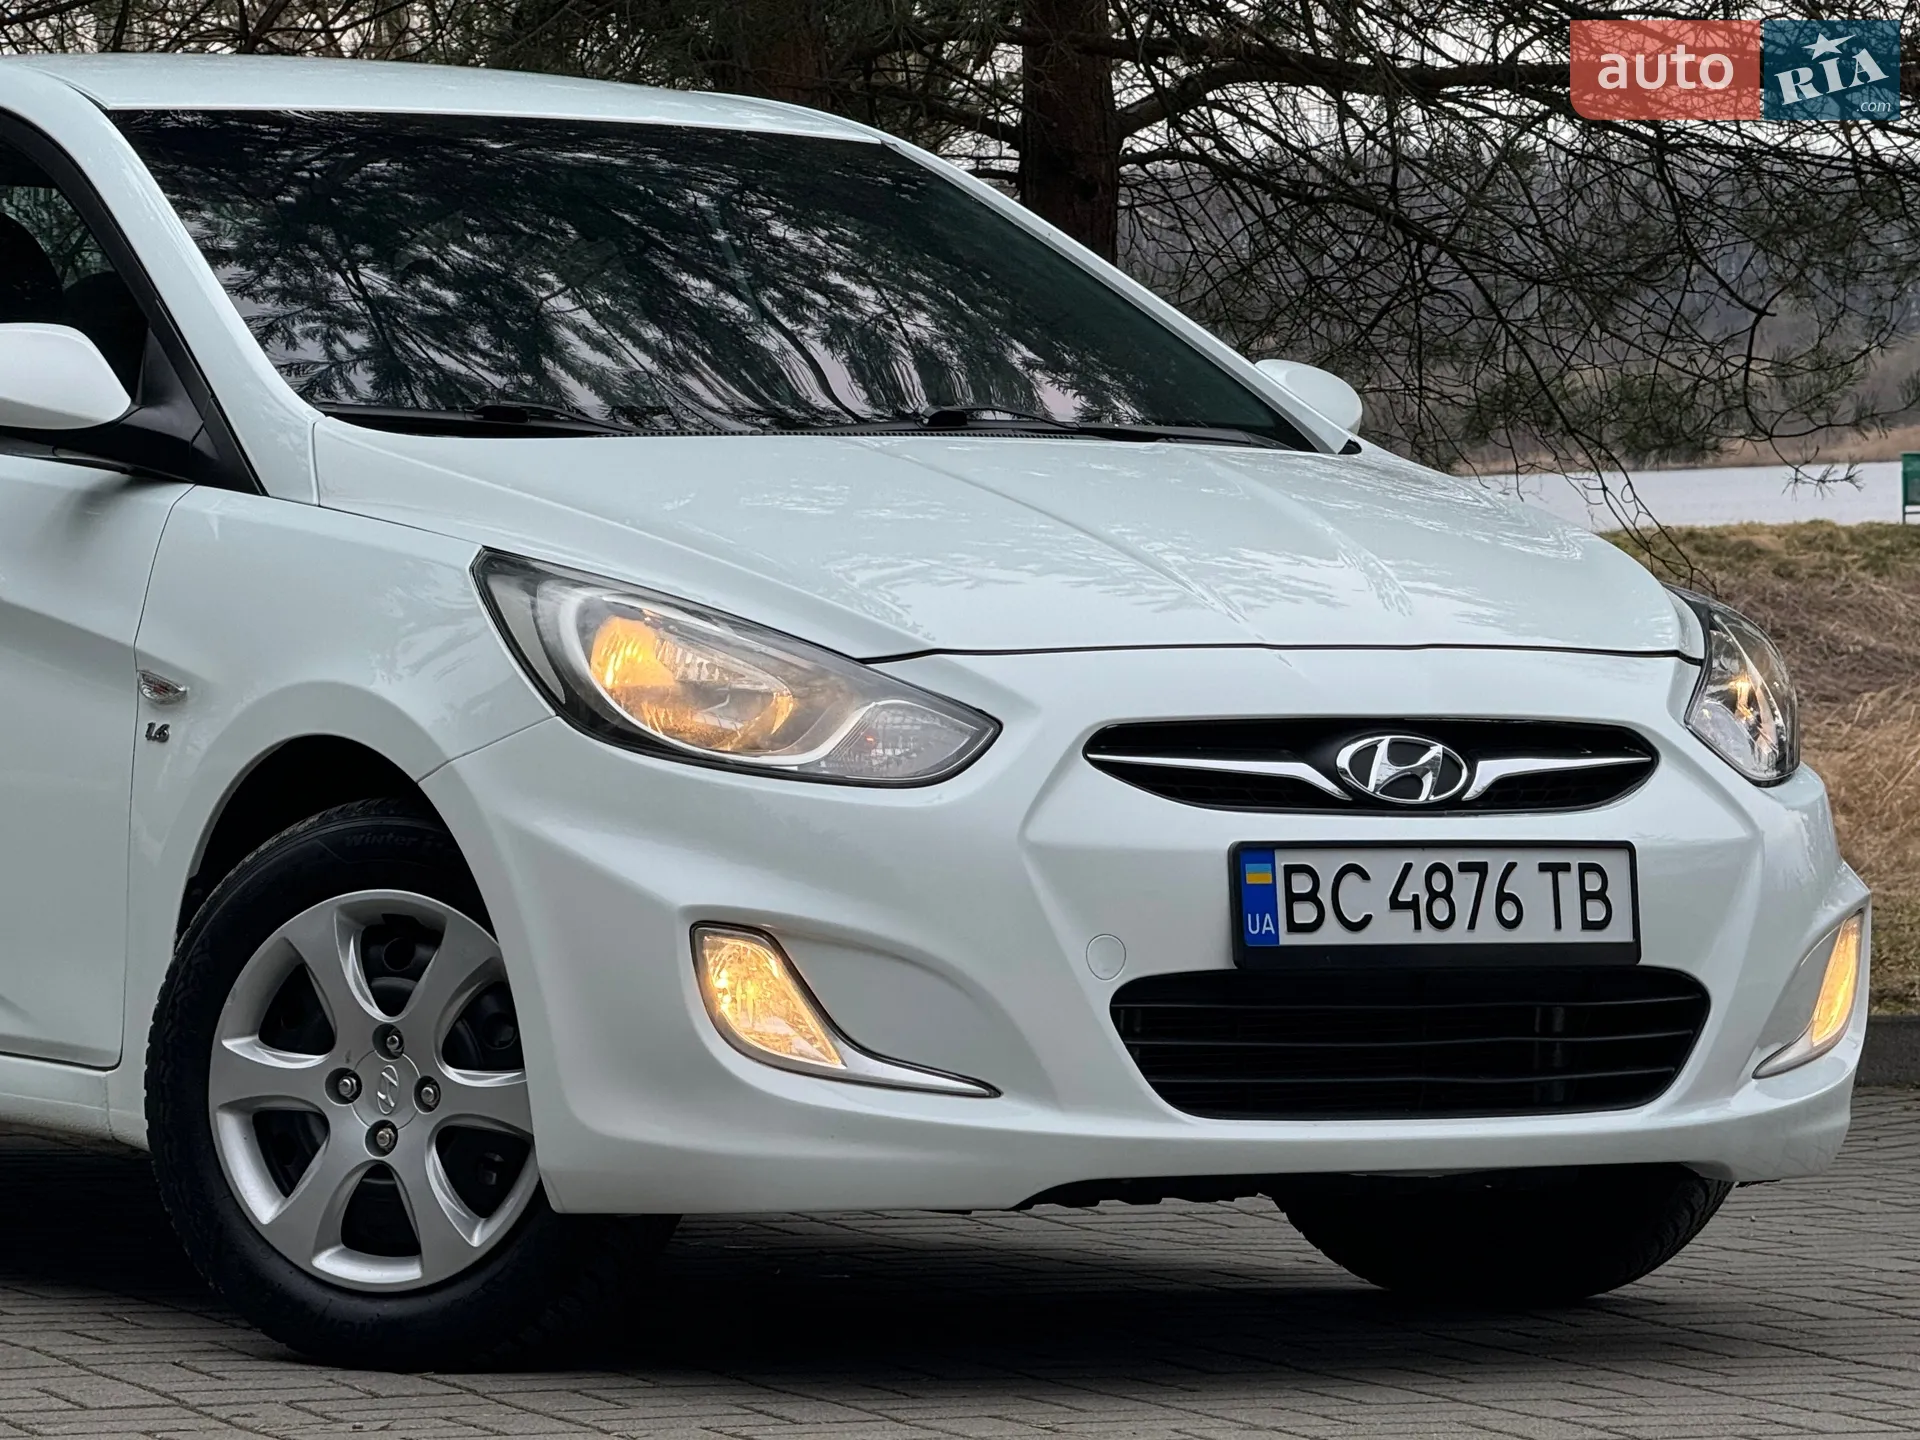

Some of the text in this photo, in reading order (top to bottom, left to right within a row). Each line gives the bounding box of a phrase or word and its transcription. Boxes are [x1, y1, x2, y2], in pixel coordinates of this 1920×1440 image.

[1282, 861, 1613, 934] BC 4876 TB
[1247, 913, 1276, 935] UA
